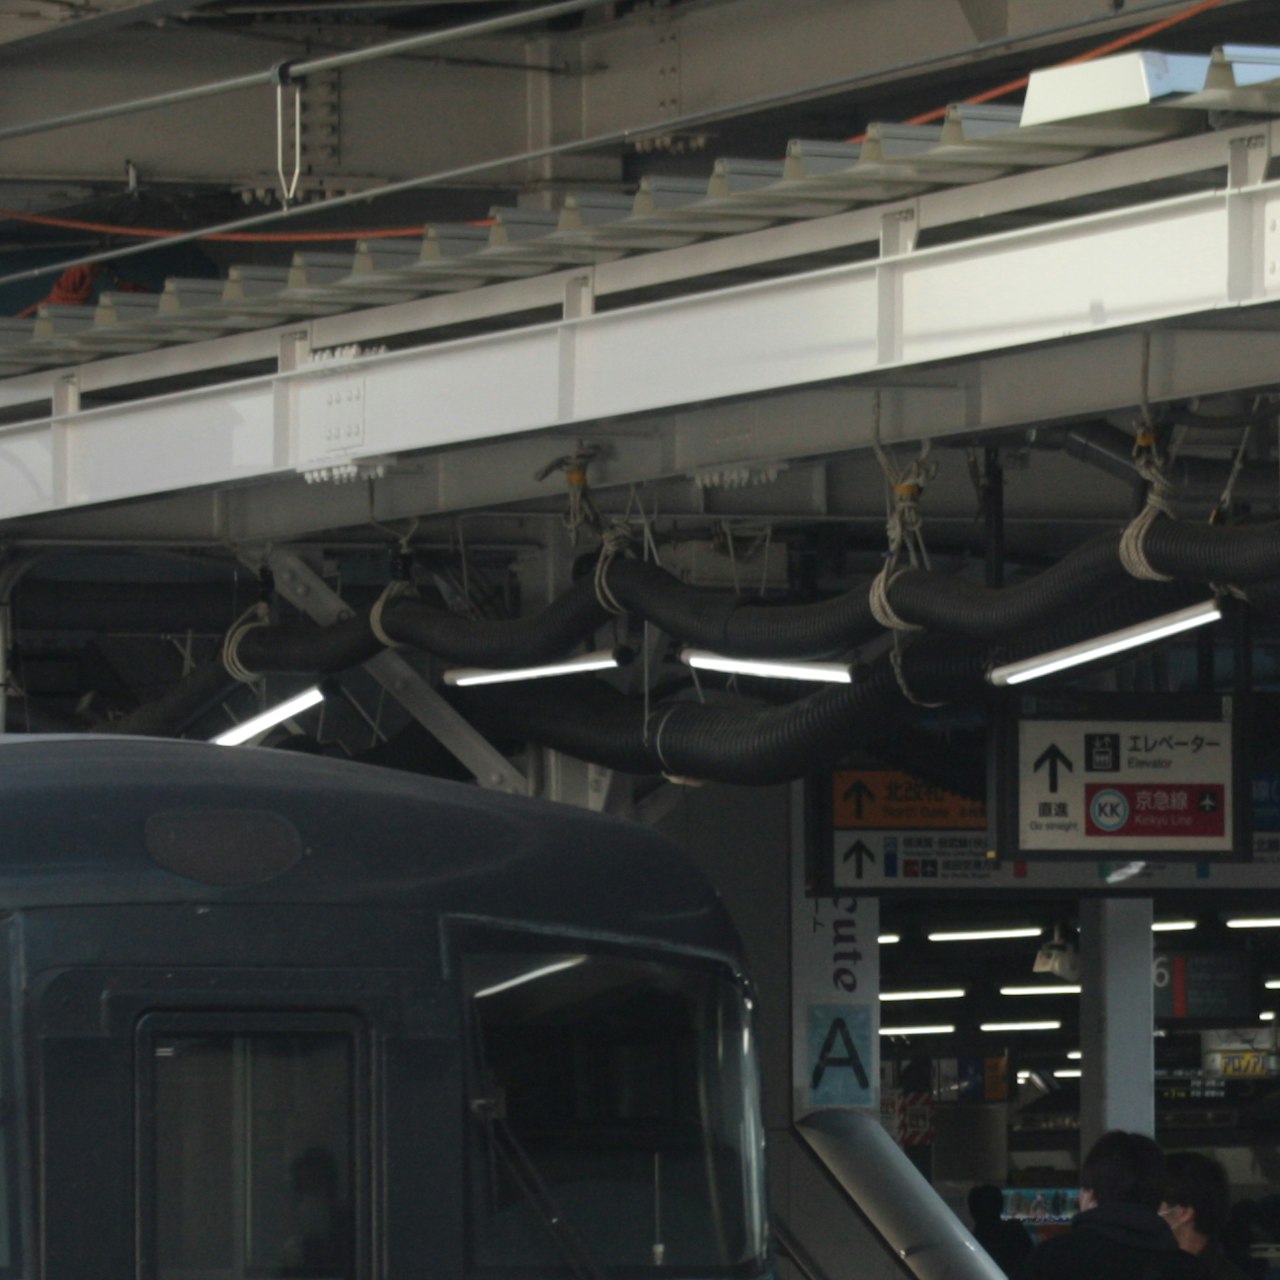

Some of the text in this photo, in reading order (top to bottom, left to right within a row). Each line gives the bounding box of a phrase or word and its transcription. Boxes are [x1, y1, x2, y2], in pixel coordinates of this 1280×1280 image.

[1128, 735, 1221, 754] エレベーター
[1127, 757, 1173, 770] Elevator
[1039, 802, 1069, 818] 直進
[1098, 801, 1122, 819] KK
[1134, 790, 1189, 812] 京急線
[1152, 956, 1170, 988] 6
[811, 1016, 870, 1091] A
